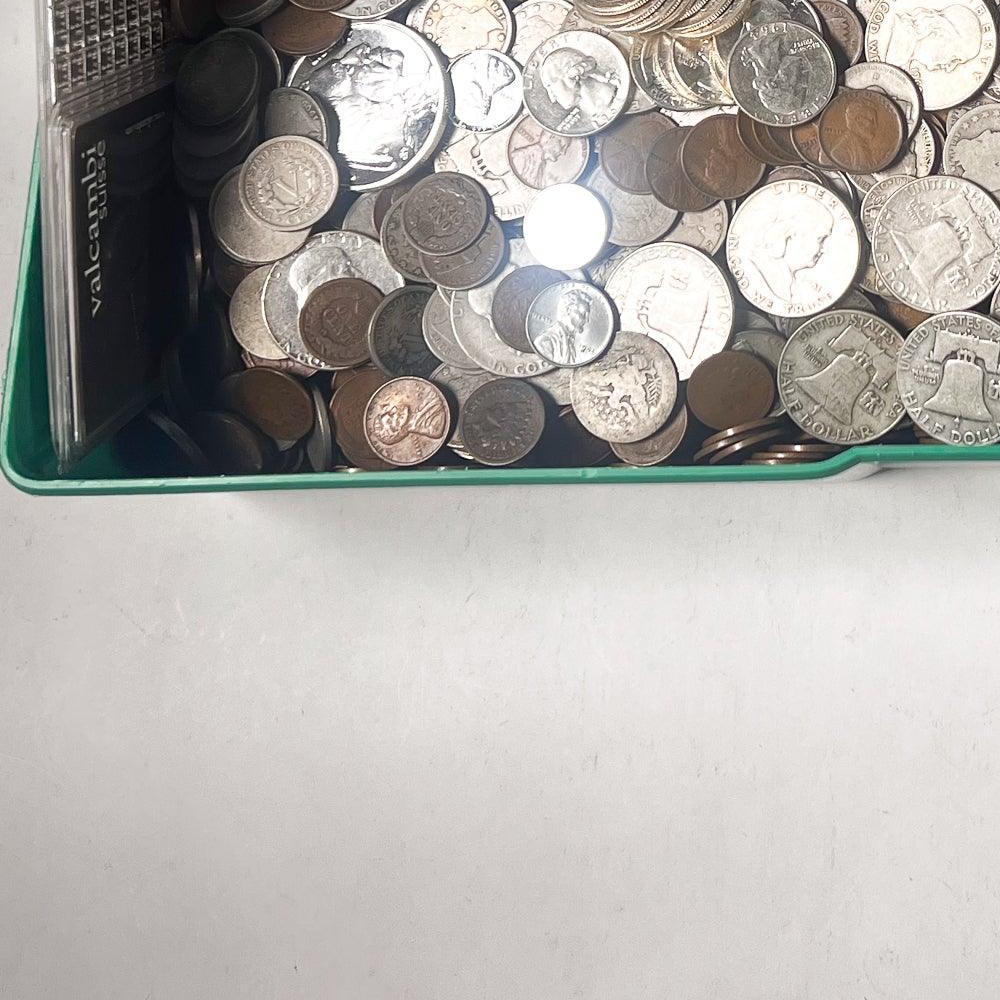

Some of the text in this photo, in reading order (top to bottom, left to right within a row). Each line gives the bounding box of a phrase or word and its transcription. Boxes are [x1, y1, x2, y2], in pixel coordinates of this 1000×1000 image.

[871, 1, 890, 34] GOD
[96, 139, 108, 220] suisse
[904, 178, 958, 196] UNITED
[81, 146, 103, 319] valcambi
[800, 313, 898, 346] UNITED STATES
[901, 326, 929, 371] UNITED
[931, 315, 983, 332] STATES
[782, 360, 875, 441] HALF DOLLAR
[903, 390, 946, 435] HALF
